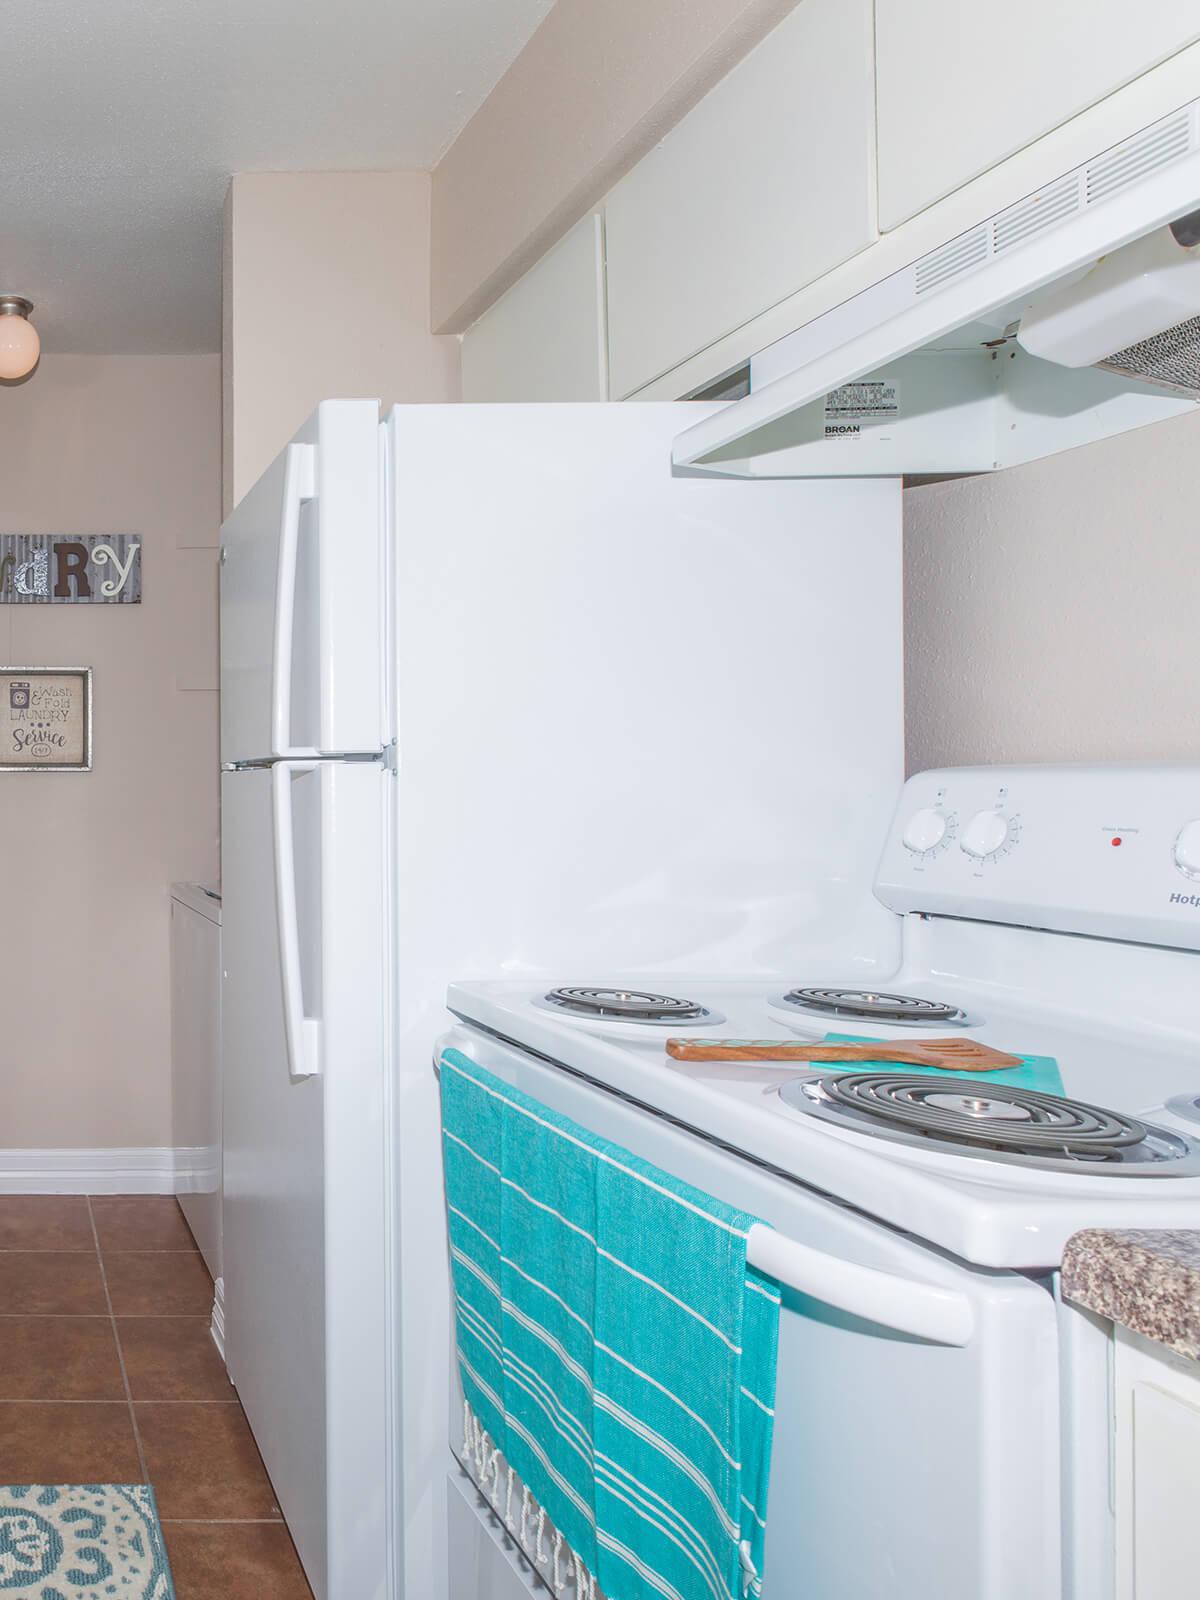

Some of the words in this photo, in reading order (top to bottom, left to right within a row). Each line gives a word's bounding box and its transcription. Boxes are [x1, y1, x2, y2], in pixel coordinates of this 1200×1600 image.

[44, 697, 70, 708] Fold
[10, 709, 69, 722] LAUNDRY
[12, 728, 67, 752] Service
